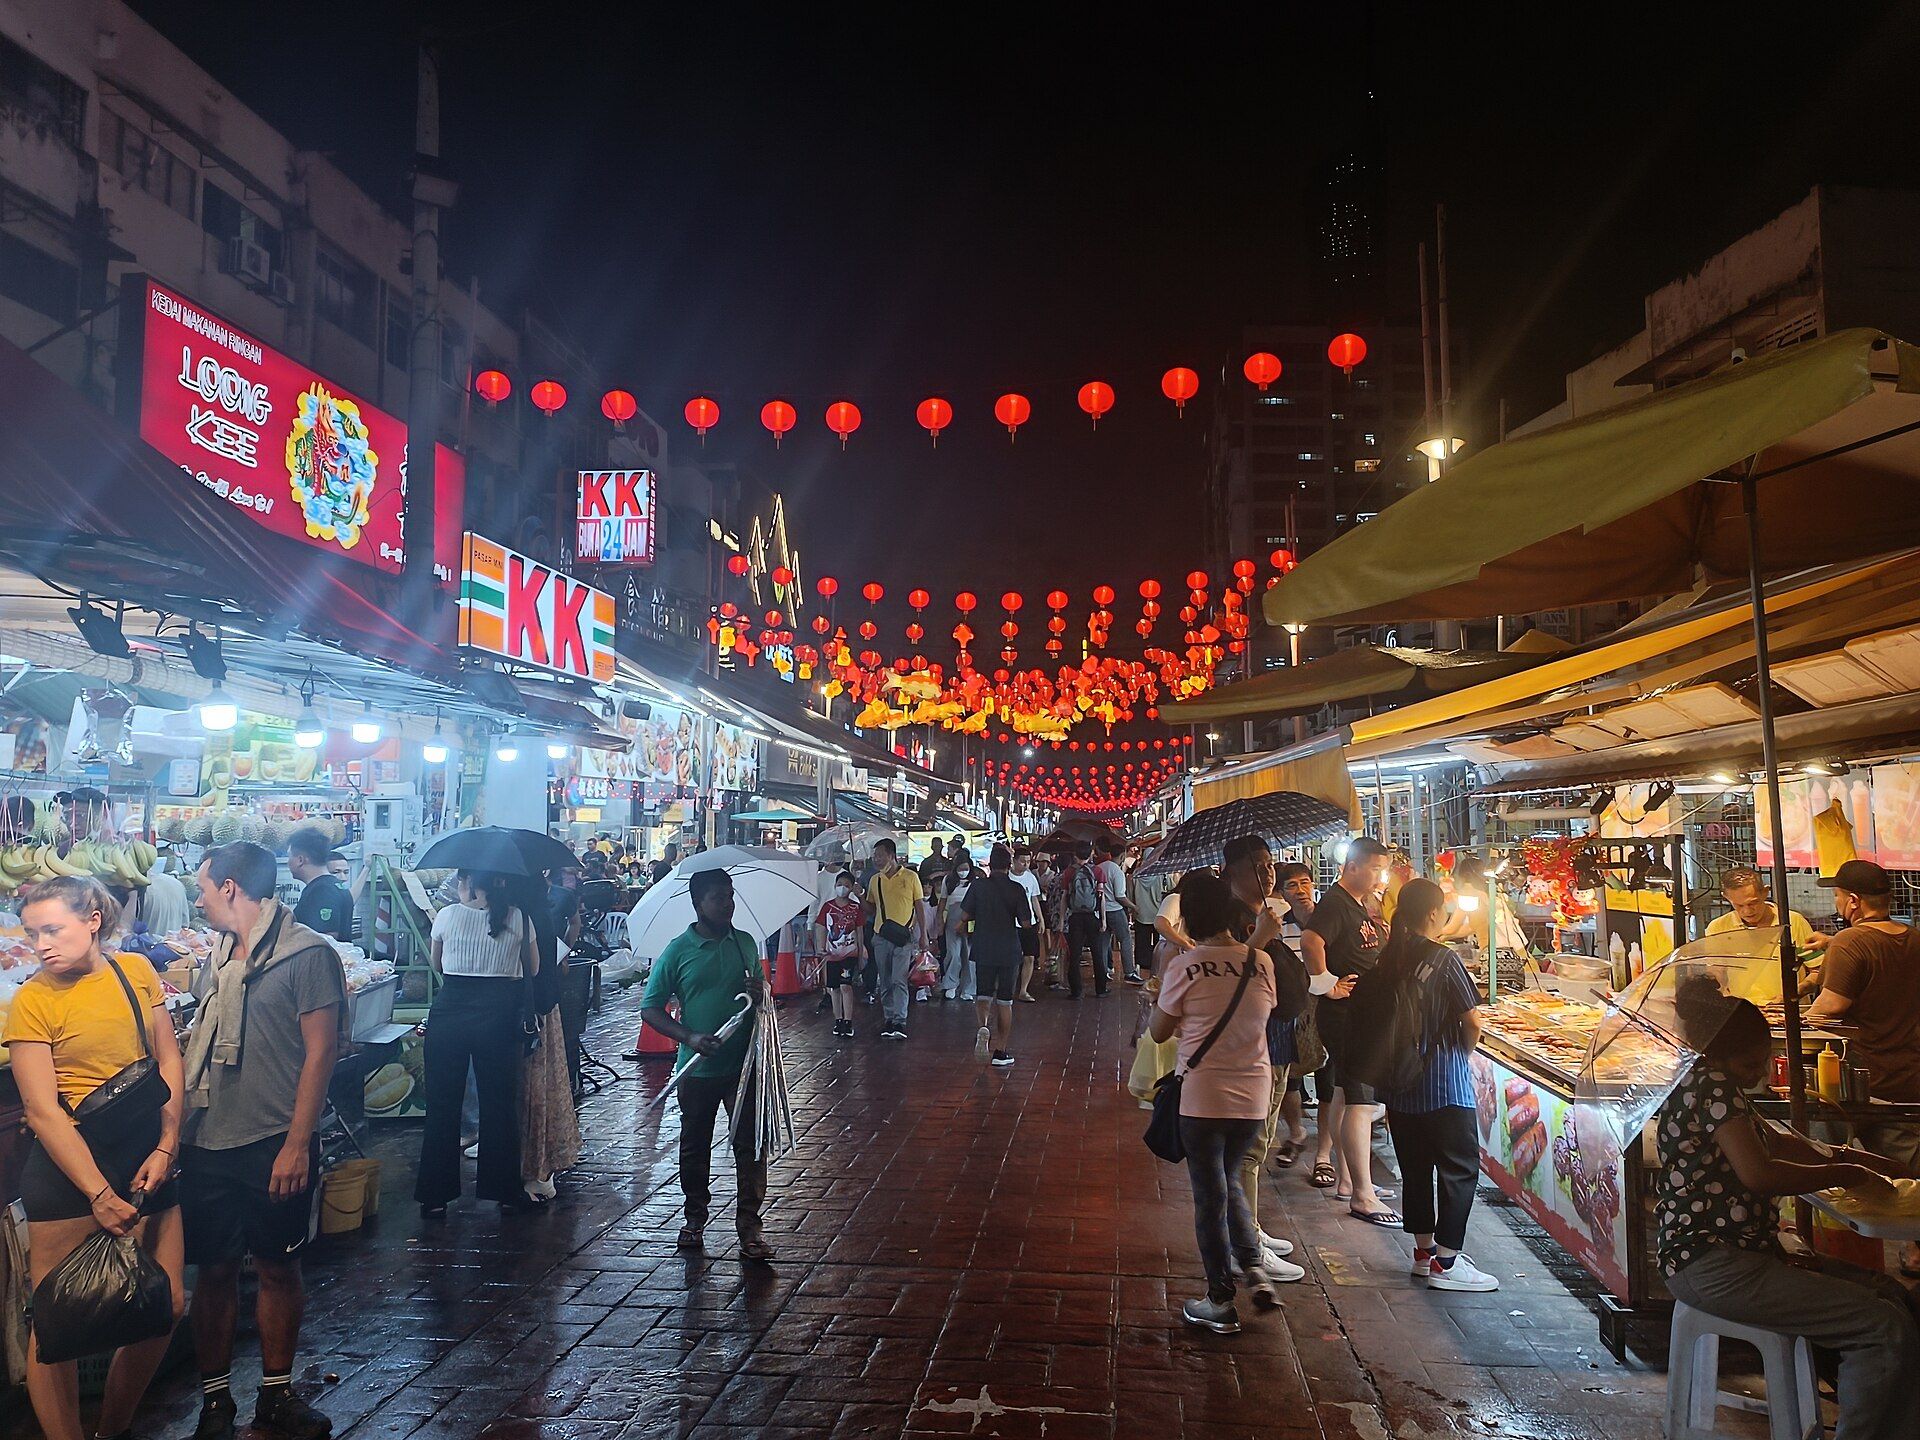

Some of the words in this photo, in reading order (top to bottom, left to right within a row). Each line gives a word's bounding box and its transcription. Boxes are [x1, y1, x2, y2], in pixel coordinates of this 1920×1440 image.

[151, 289, 182, 323] KEDAI
[182, 306, 228, 348] MAKANAN
[228, 332, 262, 366] RINGAN
[178, 345, 272, 426] LOONG
[186, 404, 259, 468] KEE
[582, 471, 645, 517] KK
[578, 522, 600, 557] BUKA
[602, 519, 622, 560] 24
[623, 522, 648, 557] JAM
[508, 554, 591, 676] KK
